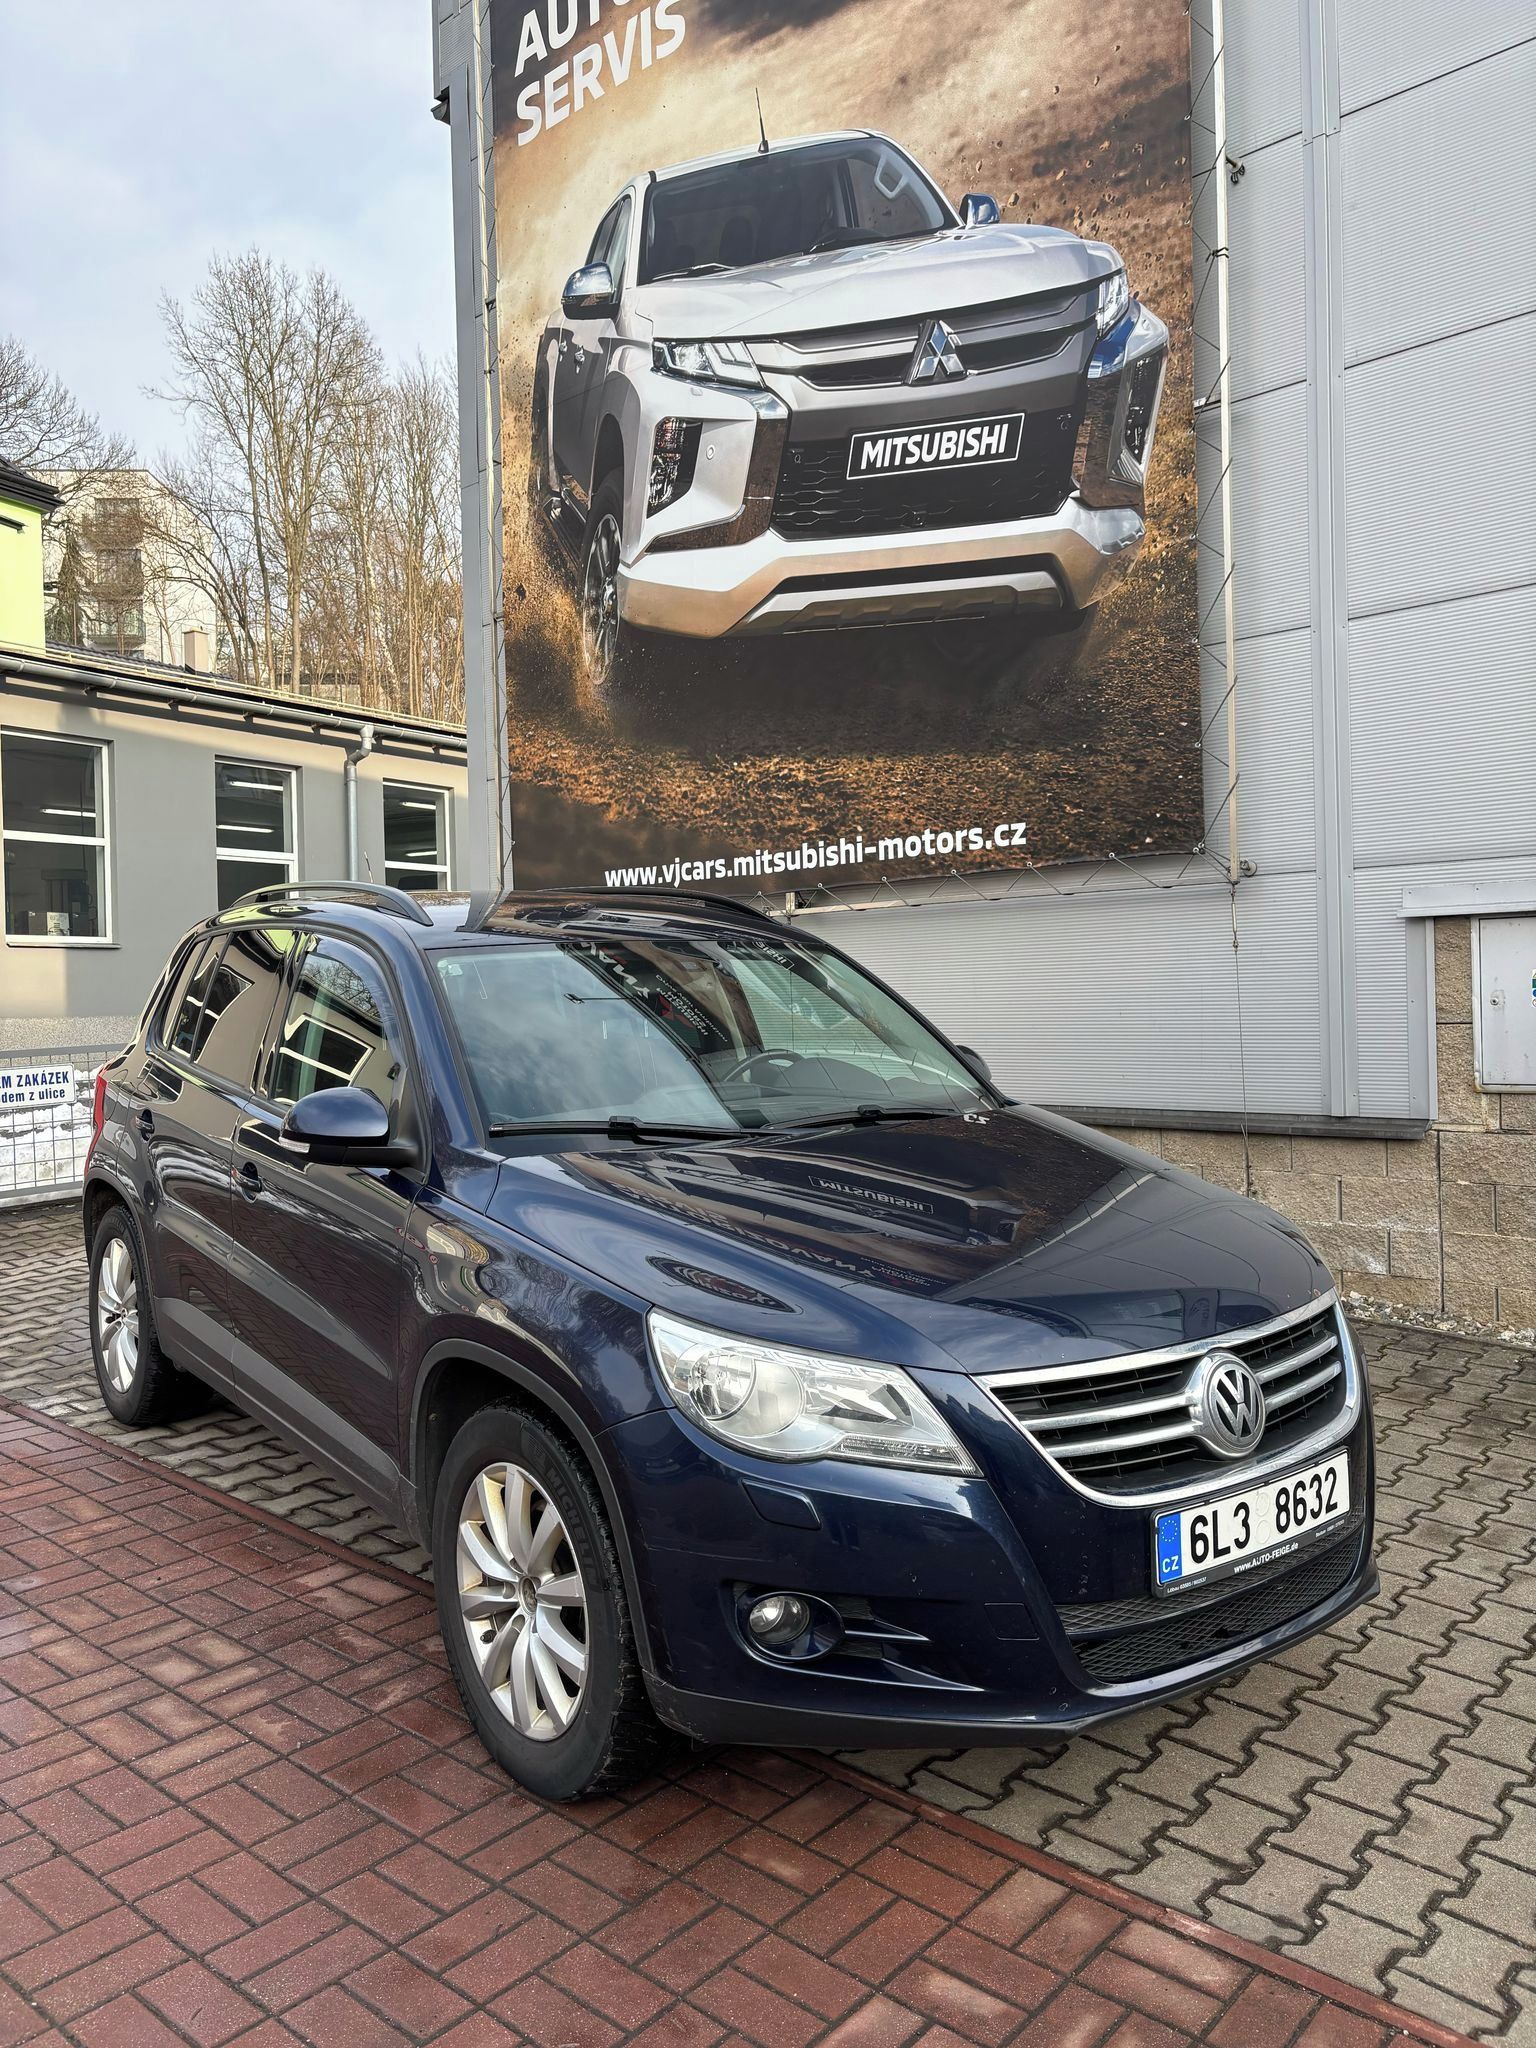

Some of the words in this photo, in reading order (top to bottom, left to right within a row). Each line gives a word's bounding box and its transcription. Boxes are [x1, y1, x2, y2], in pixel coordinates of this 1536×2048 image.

[516, 0, 686, 147] SERVIS
[860, 423, 1009, 470] MITSUBISHI
[604, 821, 1027, 889] www.vjcars.mitsubishi-motors.cz
[0, 1075, 12, 1089] M
[16, 1069, 70, 1088] ZAKÁZEK
[1, 1091, 25, 1104] dem
[28, 1093, 35, 1101] z
[38, 1088, 66, 1100] ulice
[546, 1464, 602, 1592] MICHELIN
[1189, 1501, 1251, 1565] 6L3
[1275, 1466, 1338, 1534] 8632
[1161, 1555, 1180, 1574] CZ
[1233, 1541, 1299, 1574] www.AUTO-FEIGE.de
